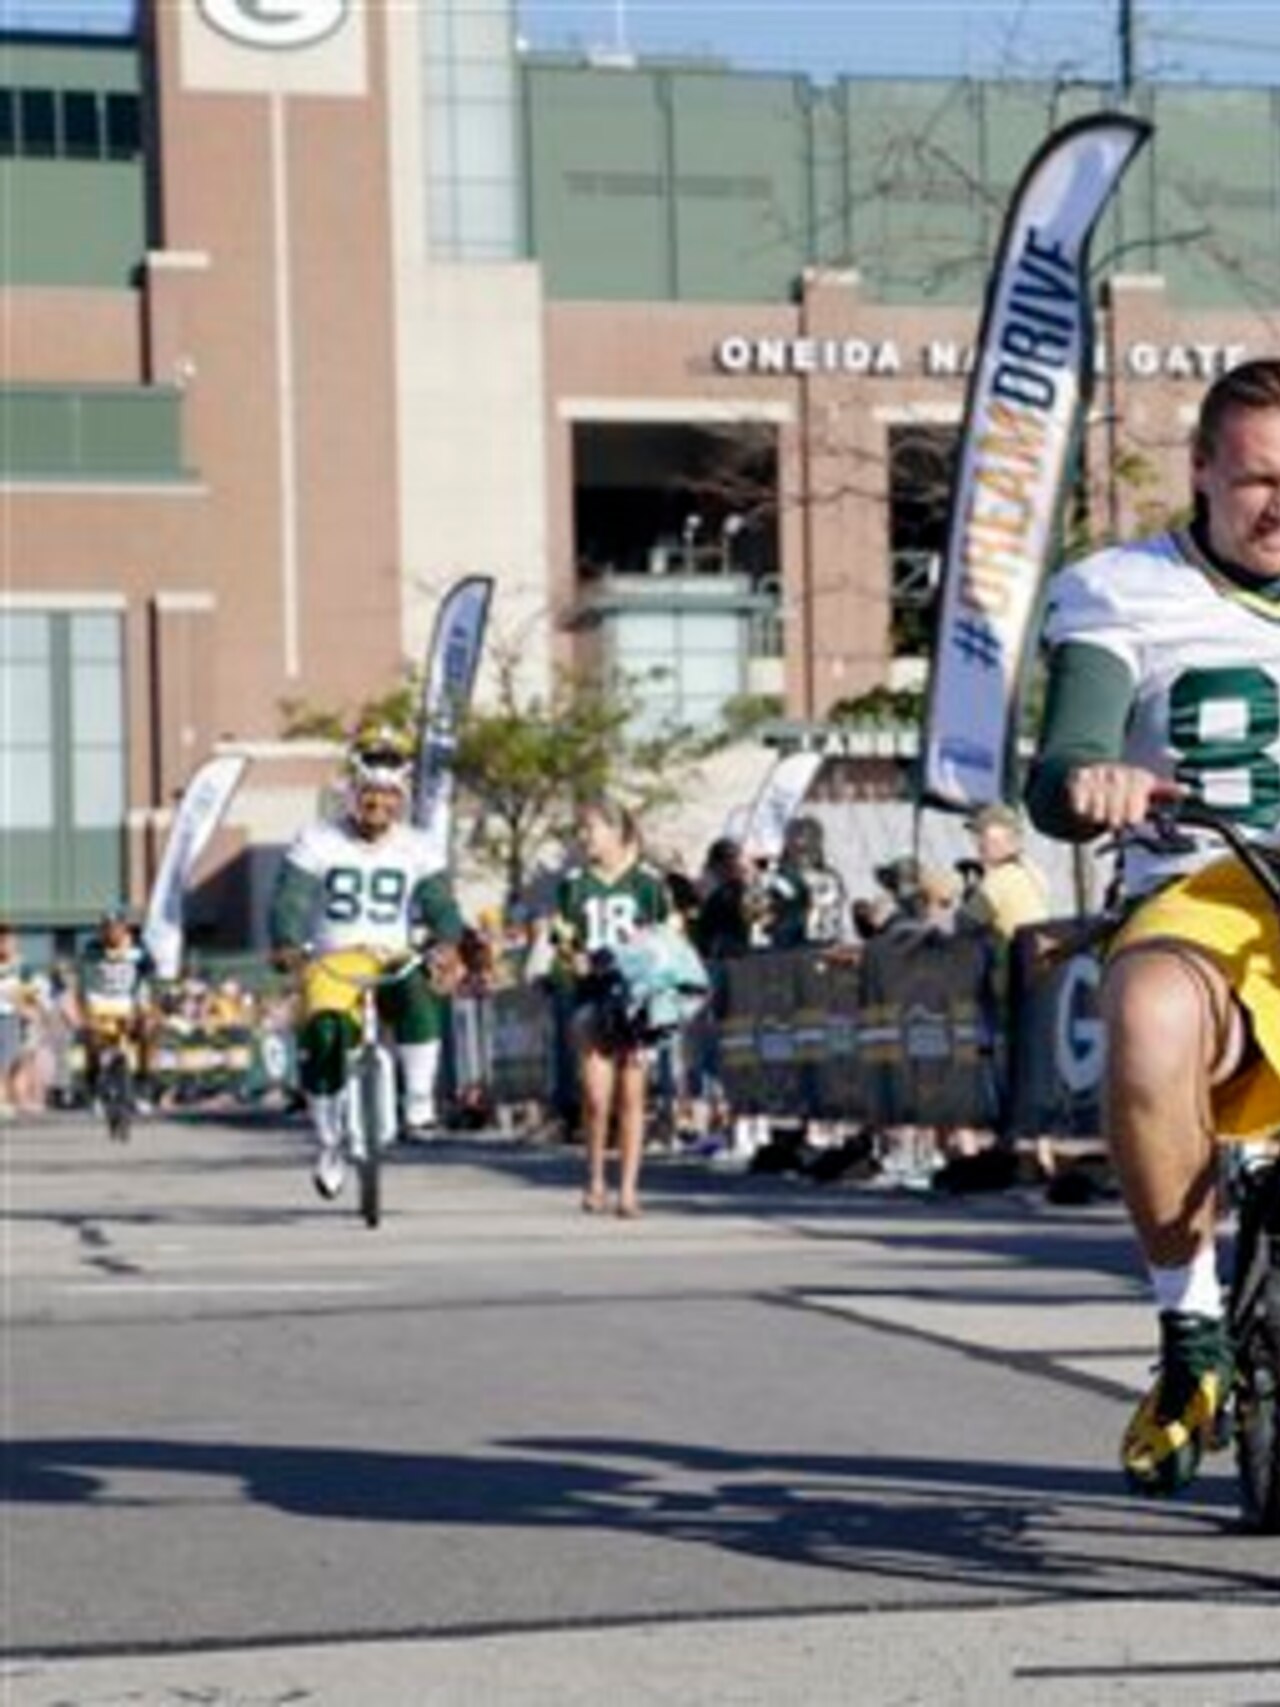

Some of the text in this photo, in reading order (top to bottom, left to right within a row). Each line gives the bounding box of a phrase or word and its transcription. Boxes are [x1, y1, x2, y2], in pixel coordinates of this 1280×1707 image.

[718, 336, 901, 372] ONEIDA
[950, 226, 1082, 670] #DREAMDRIVE
[325, 866, 406, 924] 89
